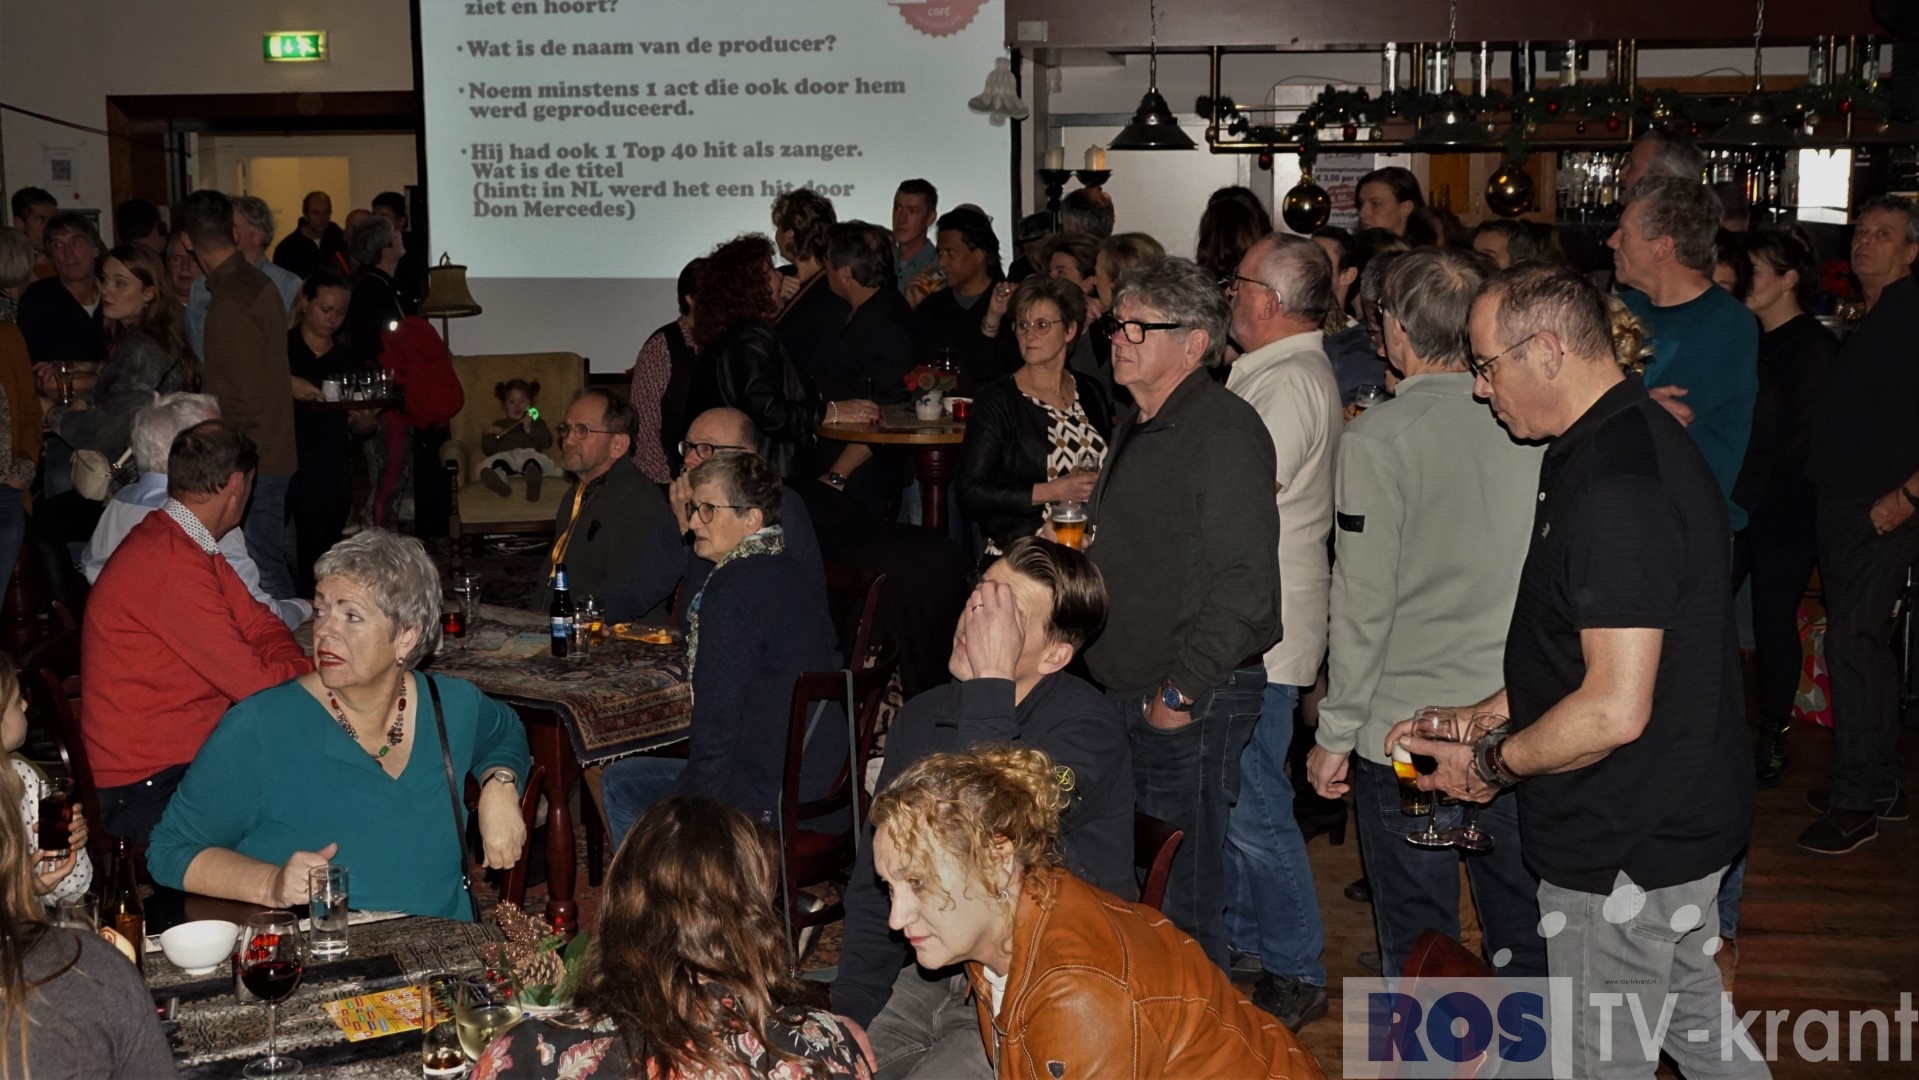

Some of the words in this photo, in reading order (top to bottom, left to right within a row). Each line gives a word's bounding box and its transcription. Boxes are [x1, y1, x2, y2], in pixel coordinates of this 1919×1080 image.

[465, 0, 506, 15] ziet
[511, 2, 538, 15] en
[543, 0, 618, 14] hoort?
[466, 40, 511, 57] Wat
[516, 39, 535, 56] is
[540, 39, 567, 56] de
[572, 42, 634, 56] naam
[639, 41, 680, 54] van
[686, 37, 713, 54] de
[718, 34, 837, 57] producer?
[468, 82, 532, 99] Noem
[537, 80, 640, 98] minstens
[646, 83, 658, 97] 1
[664, 80, 699, 96] act
[704, 79, 740, 96] die
[744, 78, 789, 95] ook
[794, 78, 850, 94] door
[854, 77, 906, 95] hem
[469, 101, 527, 119] werd
[533, 99, 695, 122] geproduceerd.
[471, 143, 503, 163] Hij
[509, 143, 551, 160] had
[556, 142, 599, 160] ook
[605, 144, 617, 159] 1
[622, 141, 666, 162] Top
[671, 143, 698, 160] 40
[703, 140, 738, 158] hit
[742, 140, 775, 158] als
[780, 143, 864, 162] zanger.
[471, 161, 515, 179] Wat
[521, 162, 539, 179] is
[544, 161, 570, 178] de
[575, 161, 624, 178] titel
[473, 181, 537, 201] (hint:
[542, 181, 565, 198] in
[571, 180, 603, 198] NL
[608, 180, 667, 197] werd
[672, 180, 710, 197] het
[715, 183, 755, 197] een
[760, 179, 795, 197] hit
[473, 199, 518, 217] Don
[523, 199, 636, 221] Mercedes)
